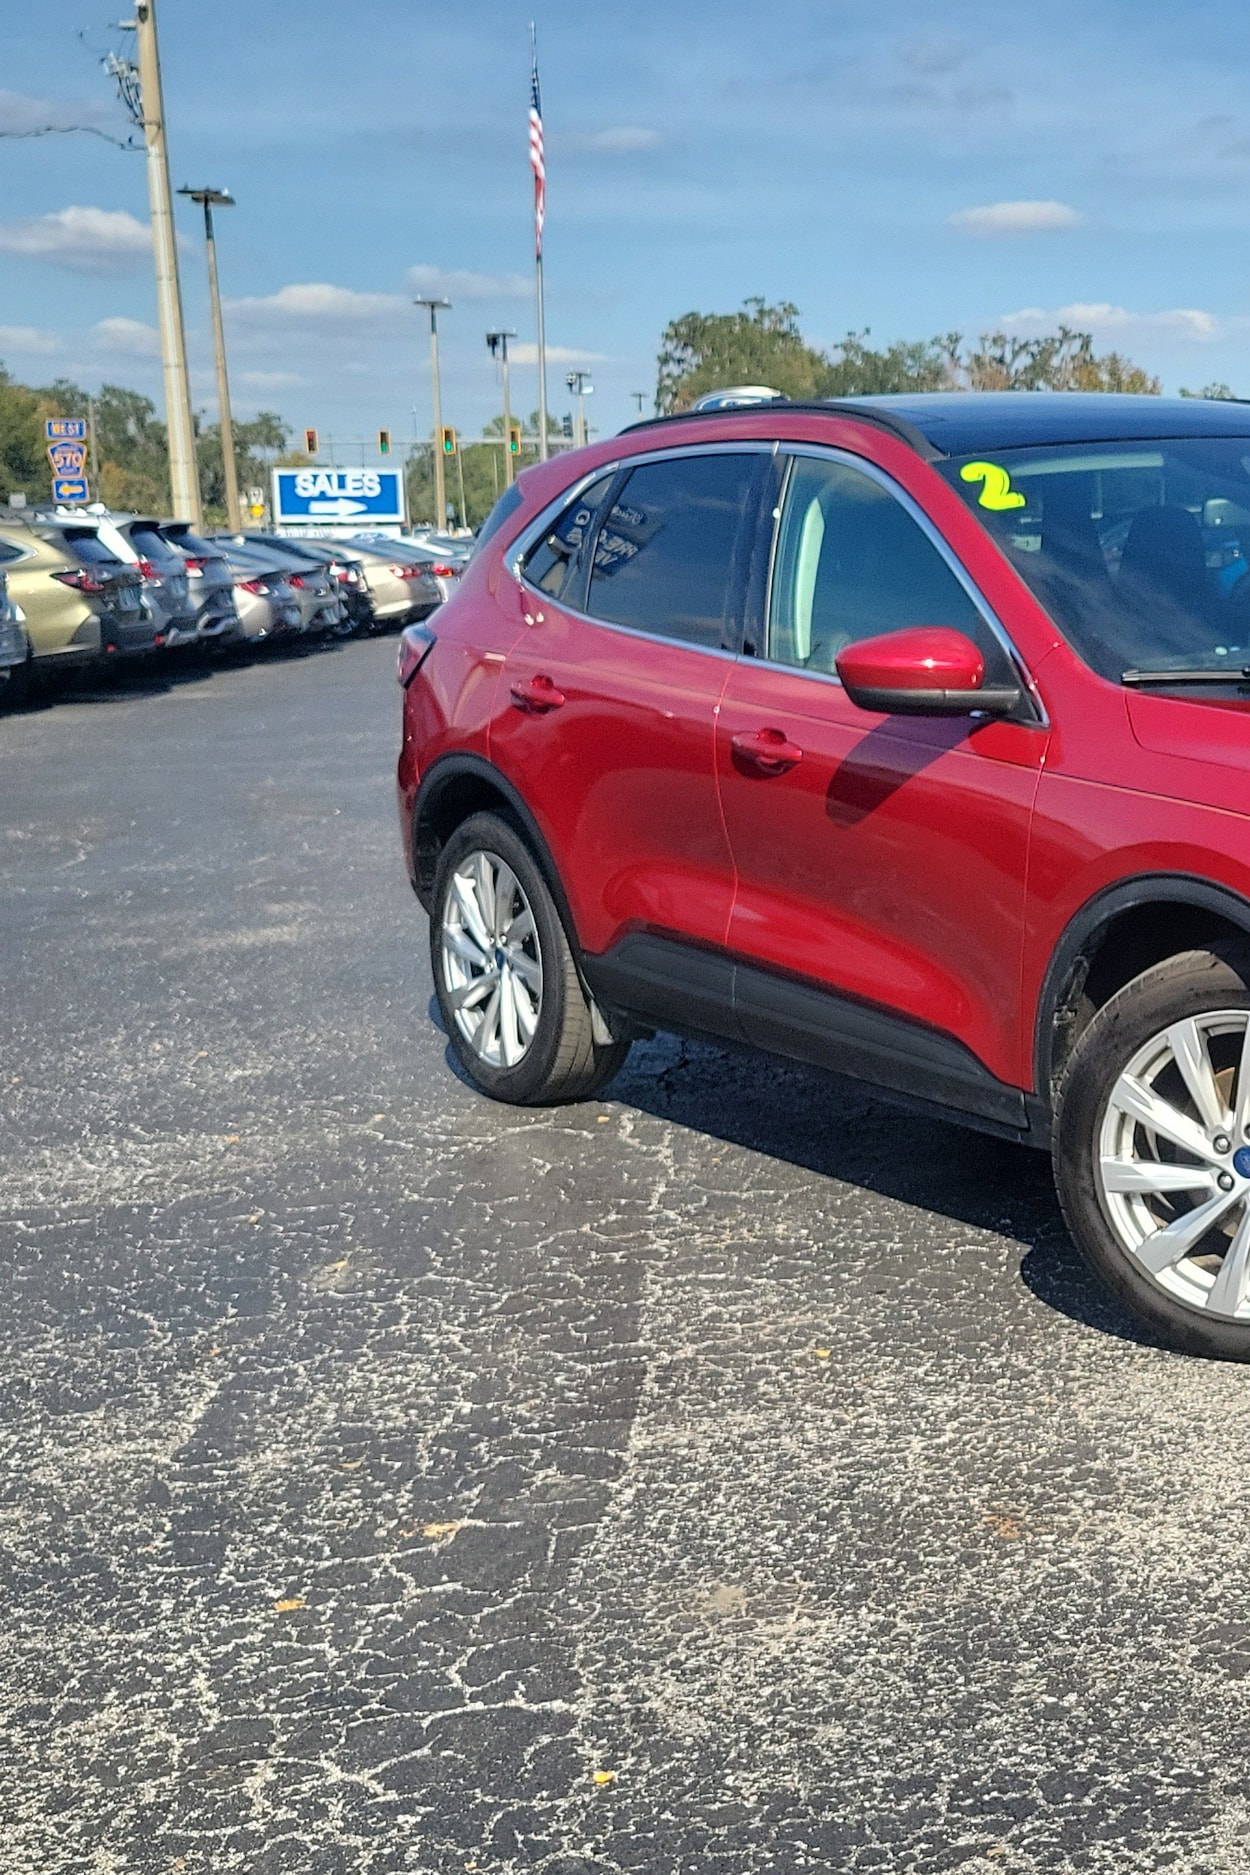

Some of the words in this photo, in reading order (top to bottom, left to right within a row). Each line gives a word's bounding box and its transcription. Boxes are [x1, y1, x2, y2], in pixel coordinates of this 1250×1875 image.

[54, 452, 83, 468] 570
[294, 472, 382, 498] SALES
[960, 461, 1026, 511] 2
